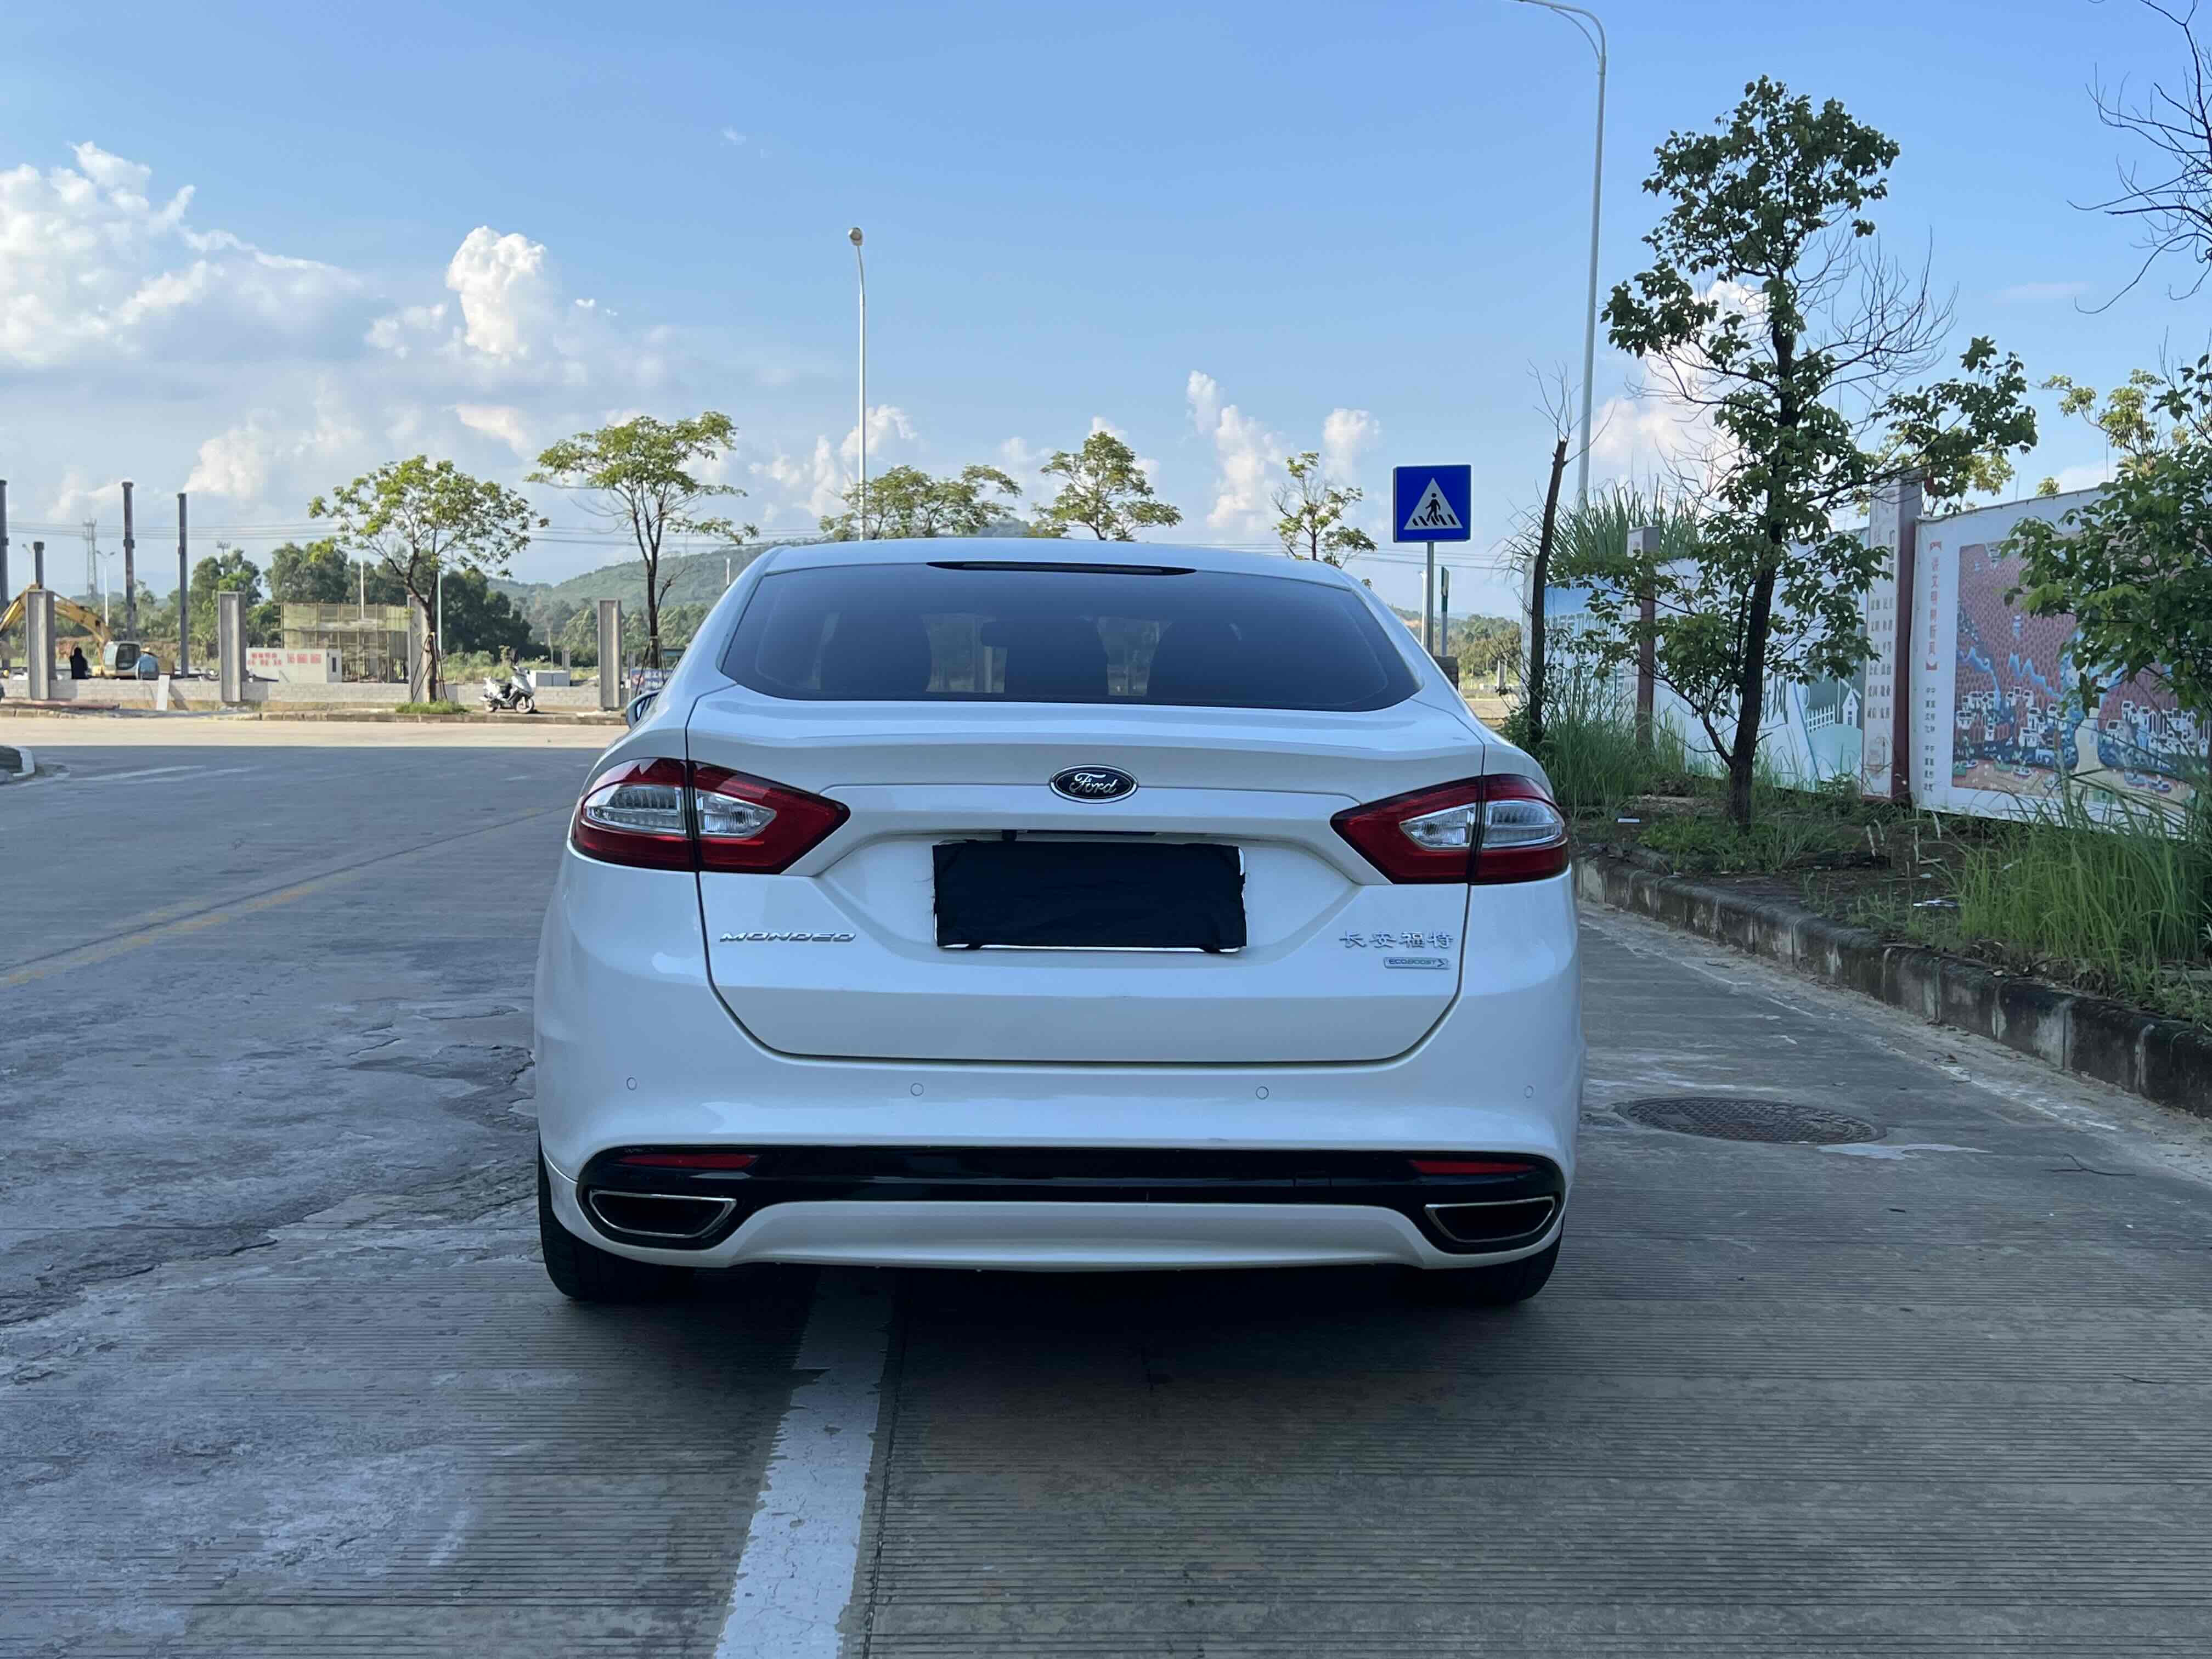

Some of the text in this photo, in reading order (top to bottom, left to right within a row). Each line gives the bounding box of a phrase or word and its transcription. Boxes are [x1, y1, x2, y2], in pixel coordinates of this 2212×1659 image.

[1069, 772, 1118, 794] Ford
[719, 932, 856, 942] MONDEO
[1339, 930, 1453, 949] 长安福特
